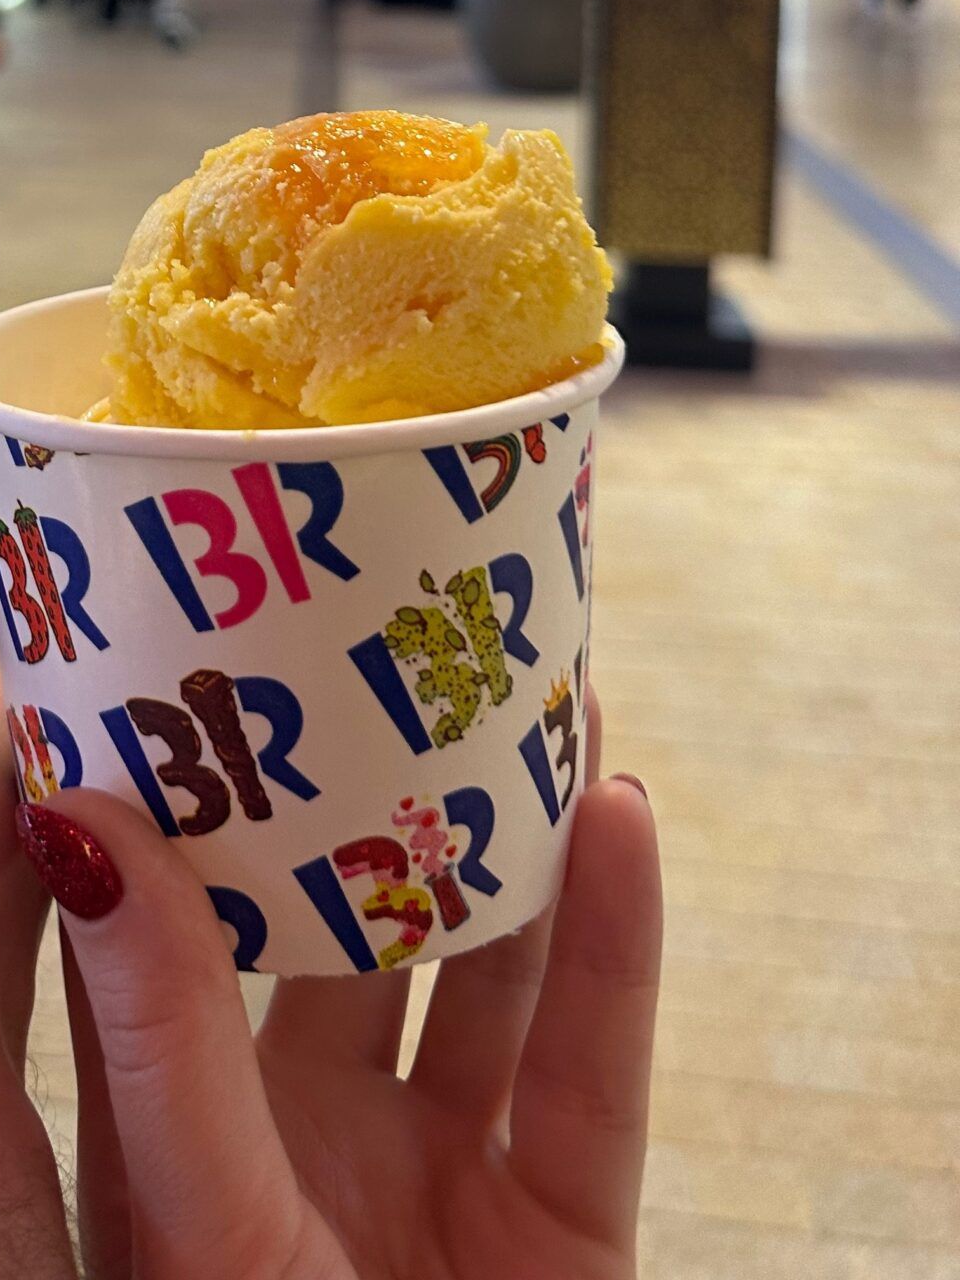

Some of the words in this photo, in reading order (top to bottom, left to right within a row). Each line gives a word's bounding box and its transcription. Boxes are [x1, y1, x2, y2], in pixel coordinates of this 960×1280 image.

[125, 461, 360, 632] BR
[348, 552, 539, 756] BR
[99, 669, 322, 837] BR
[292, 786, 503, 973] BR
